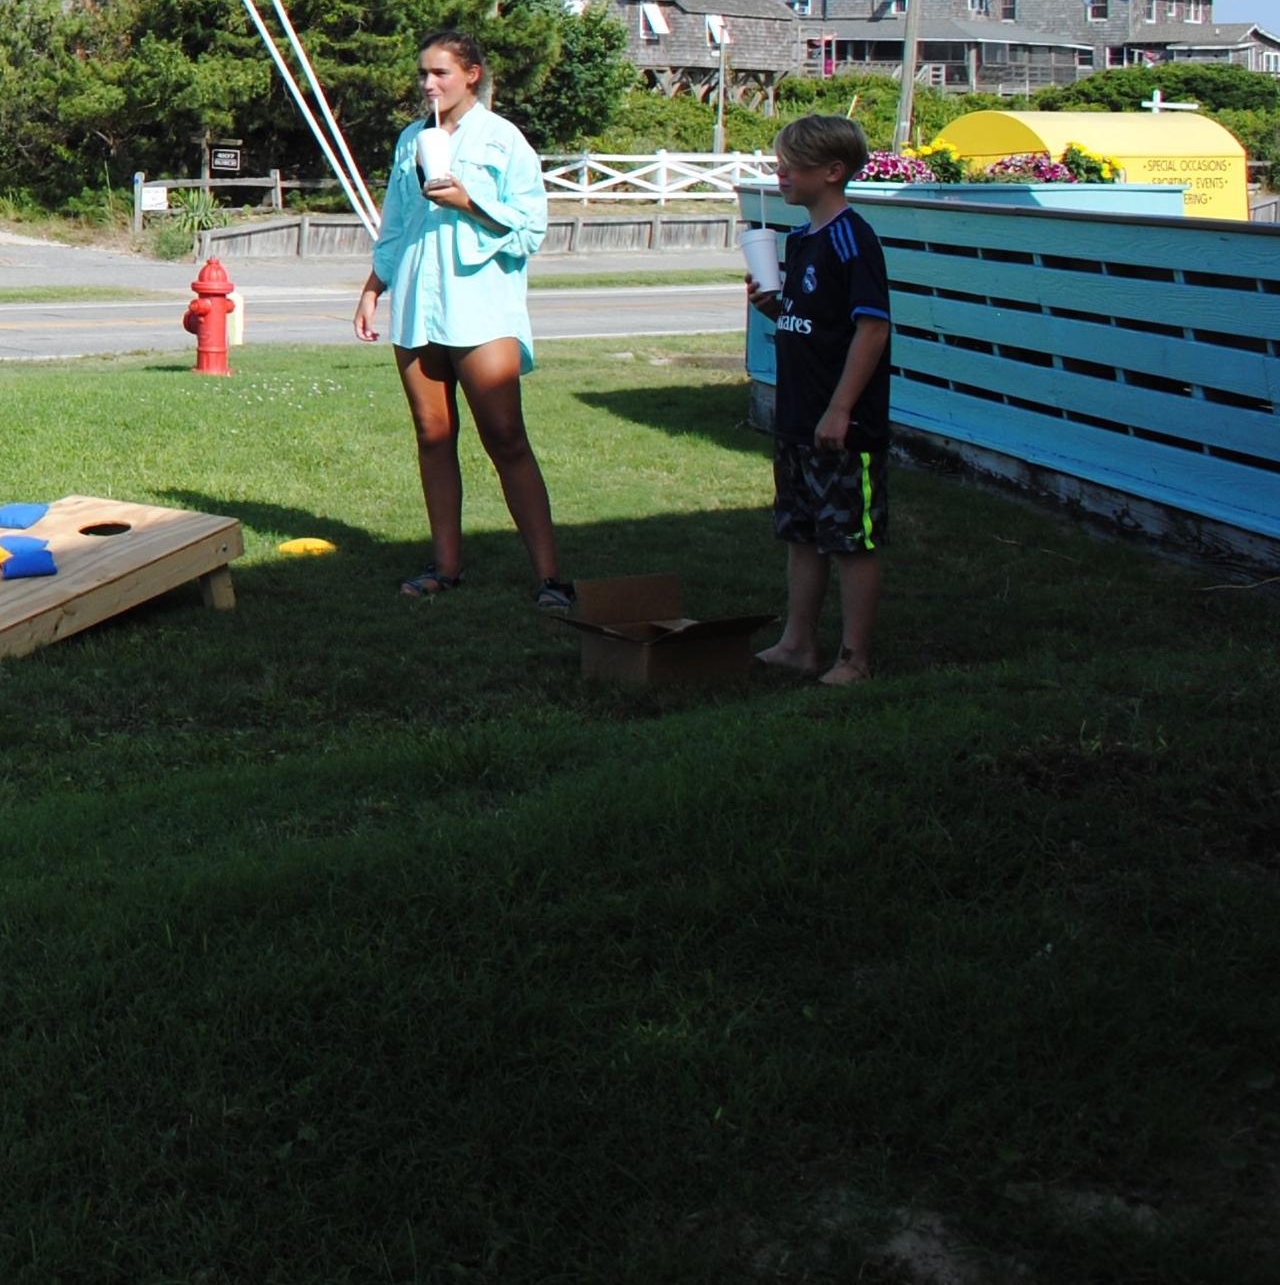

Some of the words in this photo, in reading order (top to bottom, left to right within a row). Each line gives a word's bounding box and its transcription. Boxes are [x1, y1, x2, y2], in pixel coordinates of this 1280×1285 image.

[1147, 159, 1177, 172] SPECIAL
[1180, 159, 1227, 172] OCCASIONS
[1196, 177, 1225, 189] EVENTS
[1183, 193, 1208, 205] ERING
